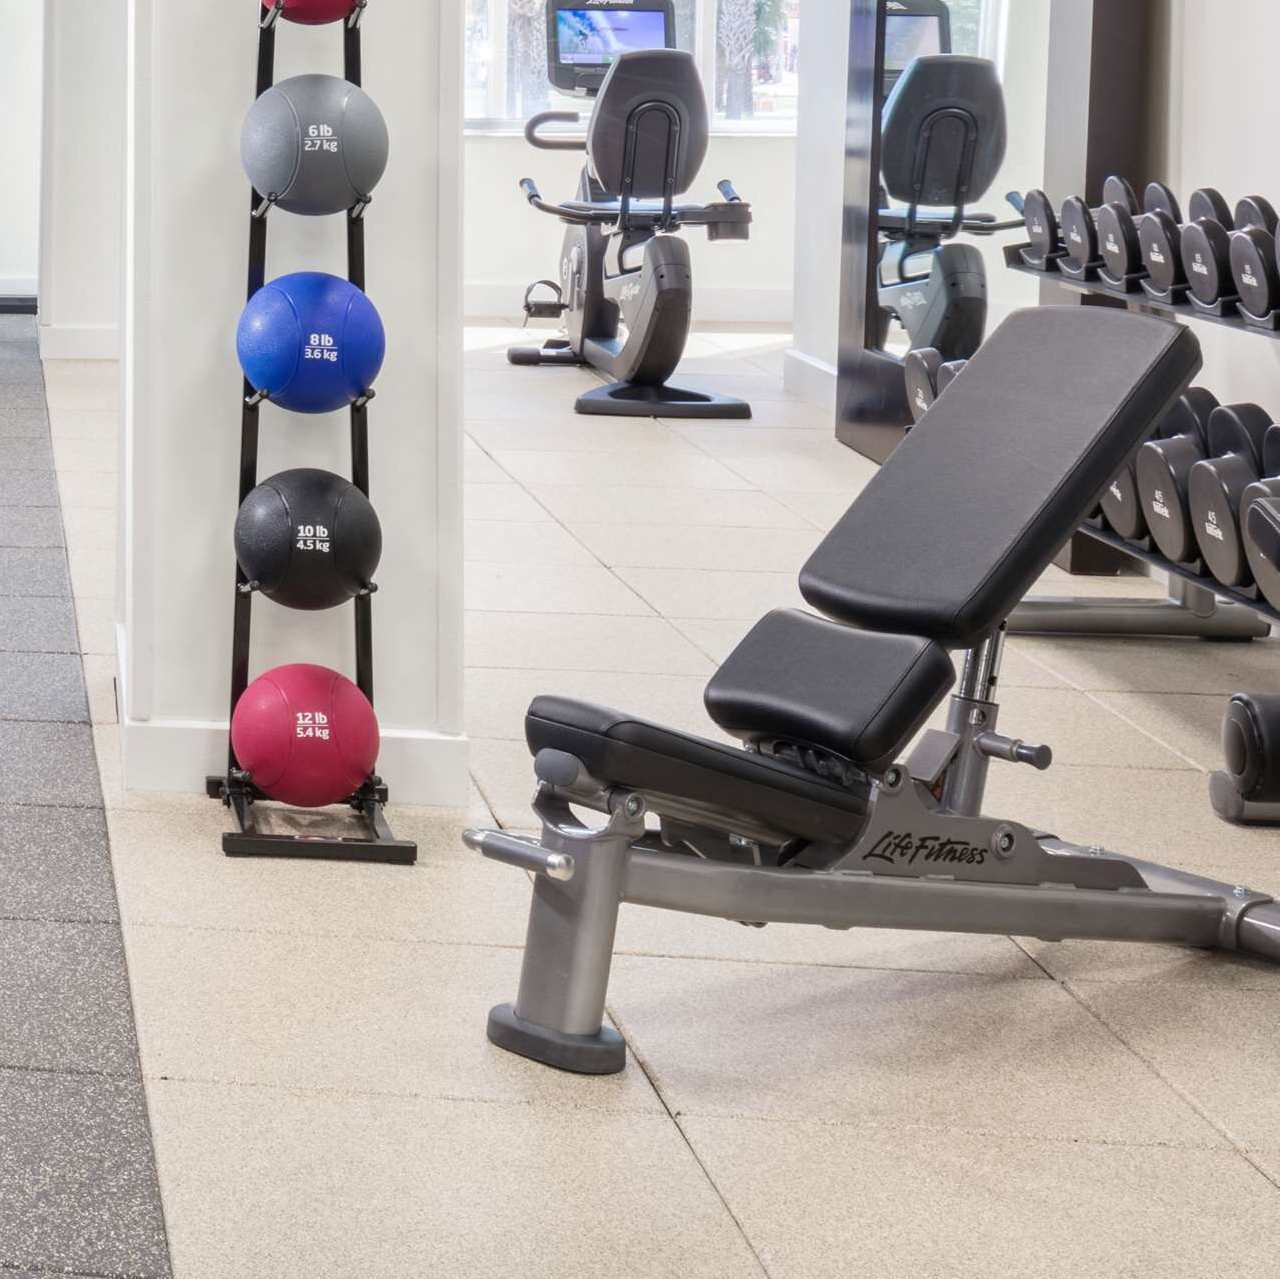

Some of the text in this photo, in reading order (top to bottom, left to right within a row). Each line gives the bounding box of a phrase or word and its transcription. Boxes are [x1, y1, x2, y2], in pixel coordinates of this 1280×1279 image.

[309, 123, 332, 137] 6 lb
[304, 139, 338, 152] 2.7 kg
[309, 333, 333, 346] 8 lb
[305, 348, 338, 362] 3.6 kg
[297, 525, 328, 537] 10 lb
[297, 539, 330, 552] 4.5 kg
[296, 712, 327, 724] 12 lb
[296, 727, 330, 740] 5.4 kg
[862, 830, 989, 866] Life Fitness
